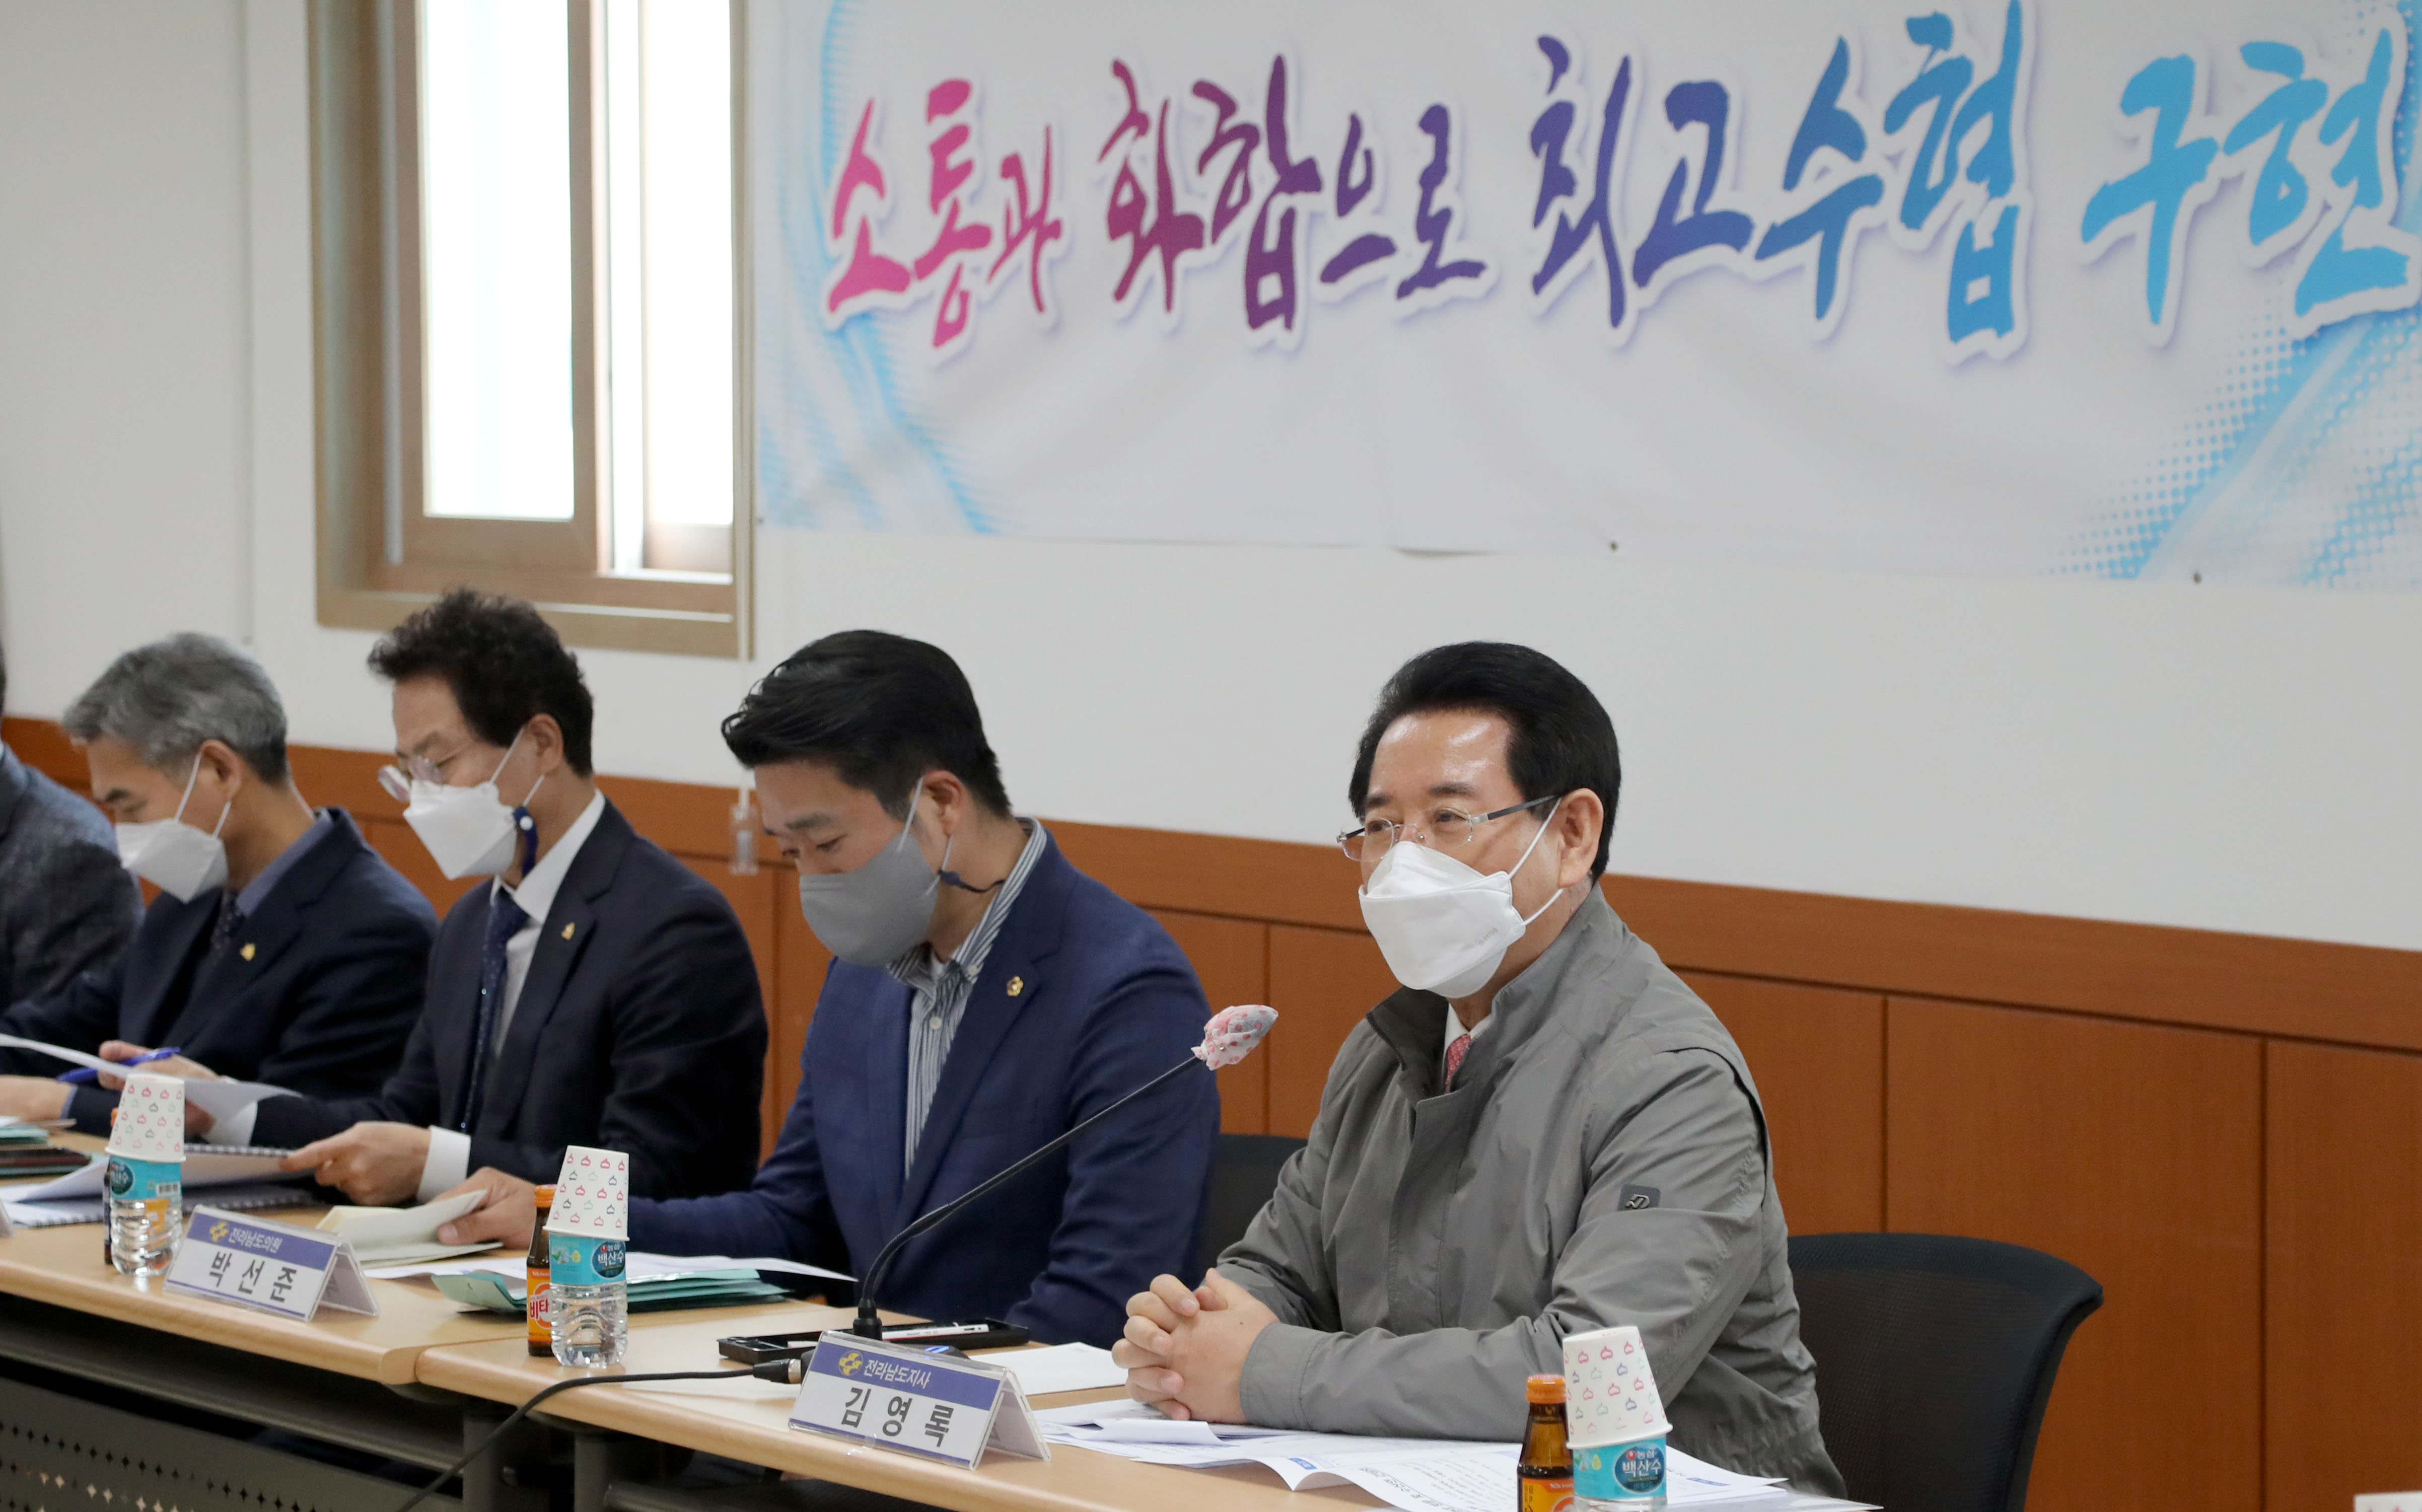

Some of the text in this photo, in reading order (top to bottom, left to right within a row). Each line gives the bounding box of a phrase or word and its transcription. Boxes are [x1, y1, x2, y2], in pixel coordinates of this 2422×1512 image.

[829, 79, 1062, 347] 소통과
[1098, 54, 1487, 330] 화합으로
[2082, 28, 2410, 325] 구현
[228, 1228, 283, 1253] 전라남도의원
[598, 1251, 624, 1266] 백산수
[864, 1359, 931, 1389] 전라남도지사
[1622, 1459, 1662, 1478] 백산수
